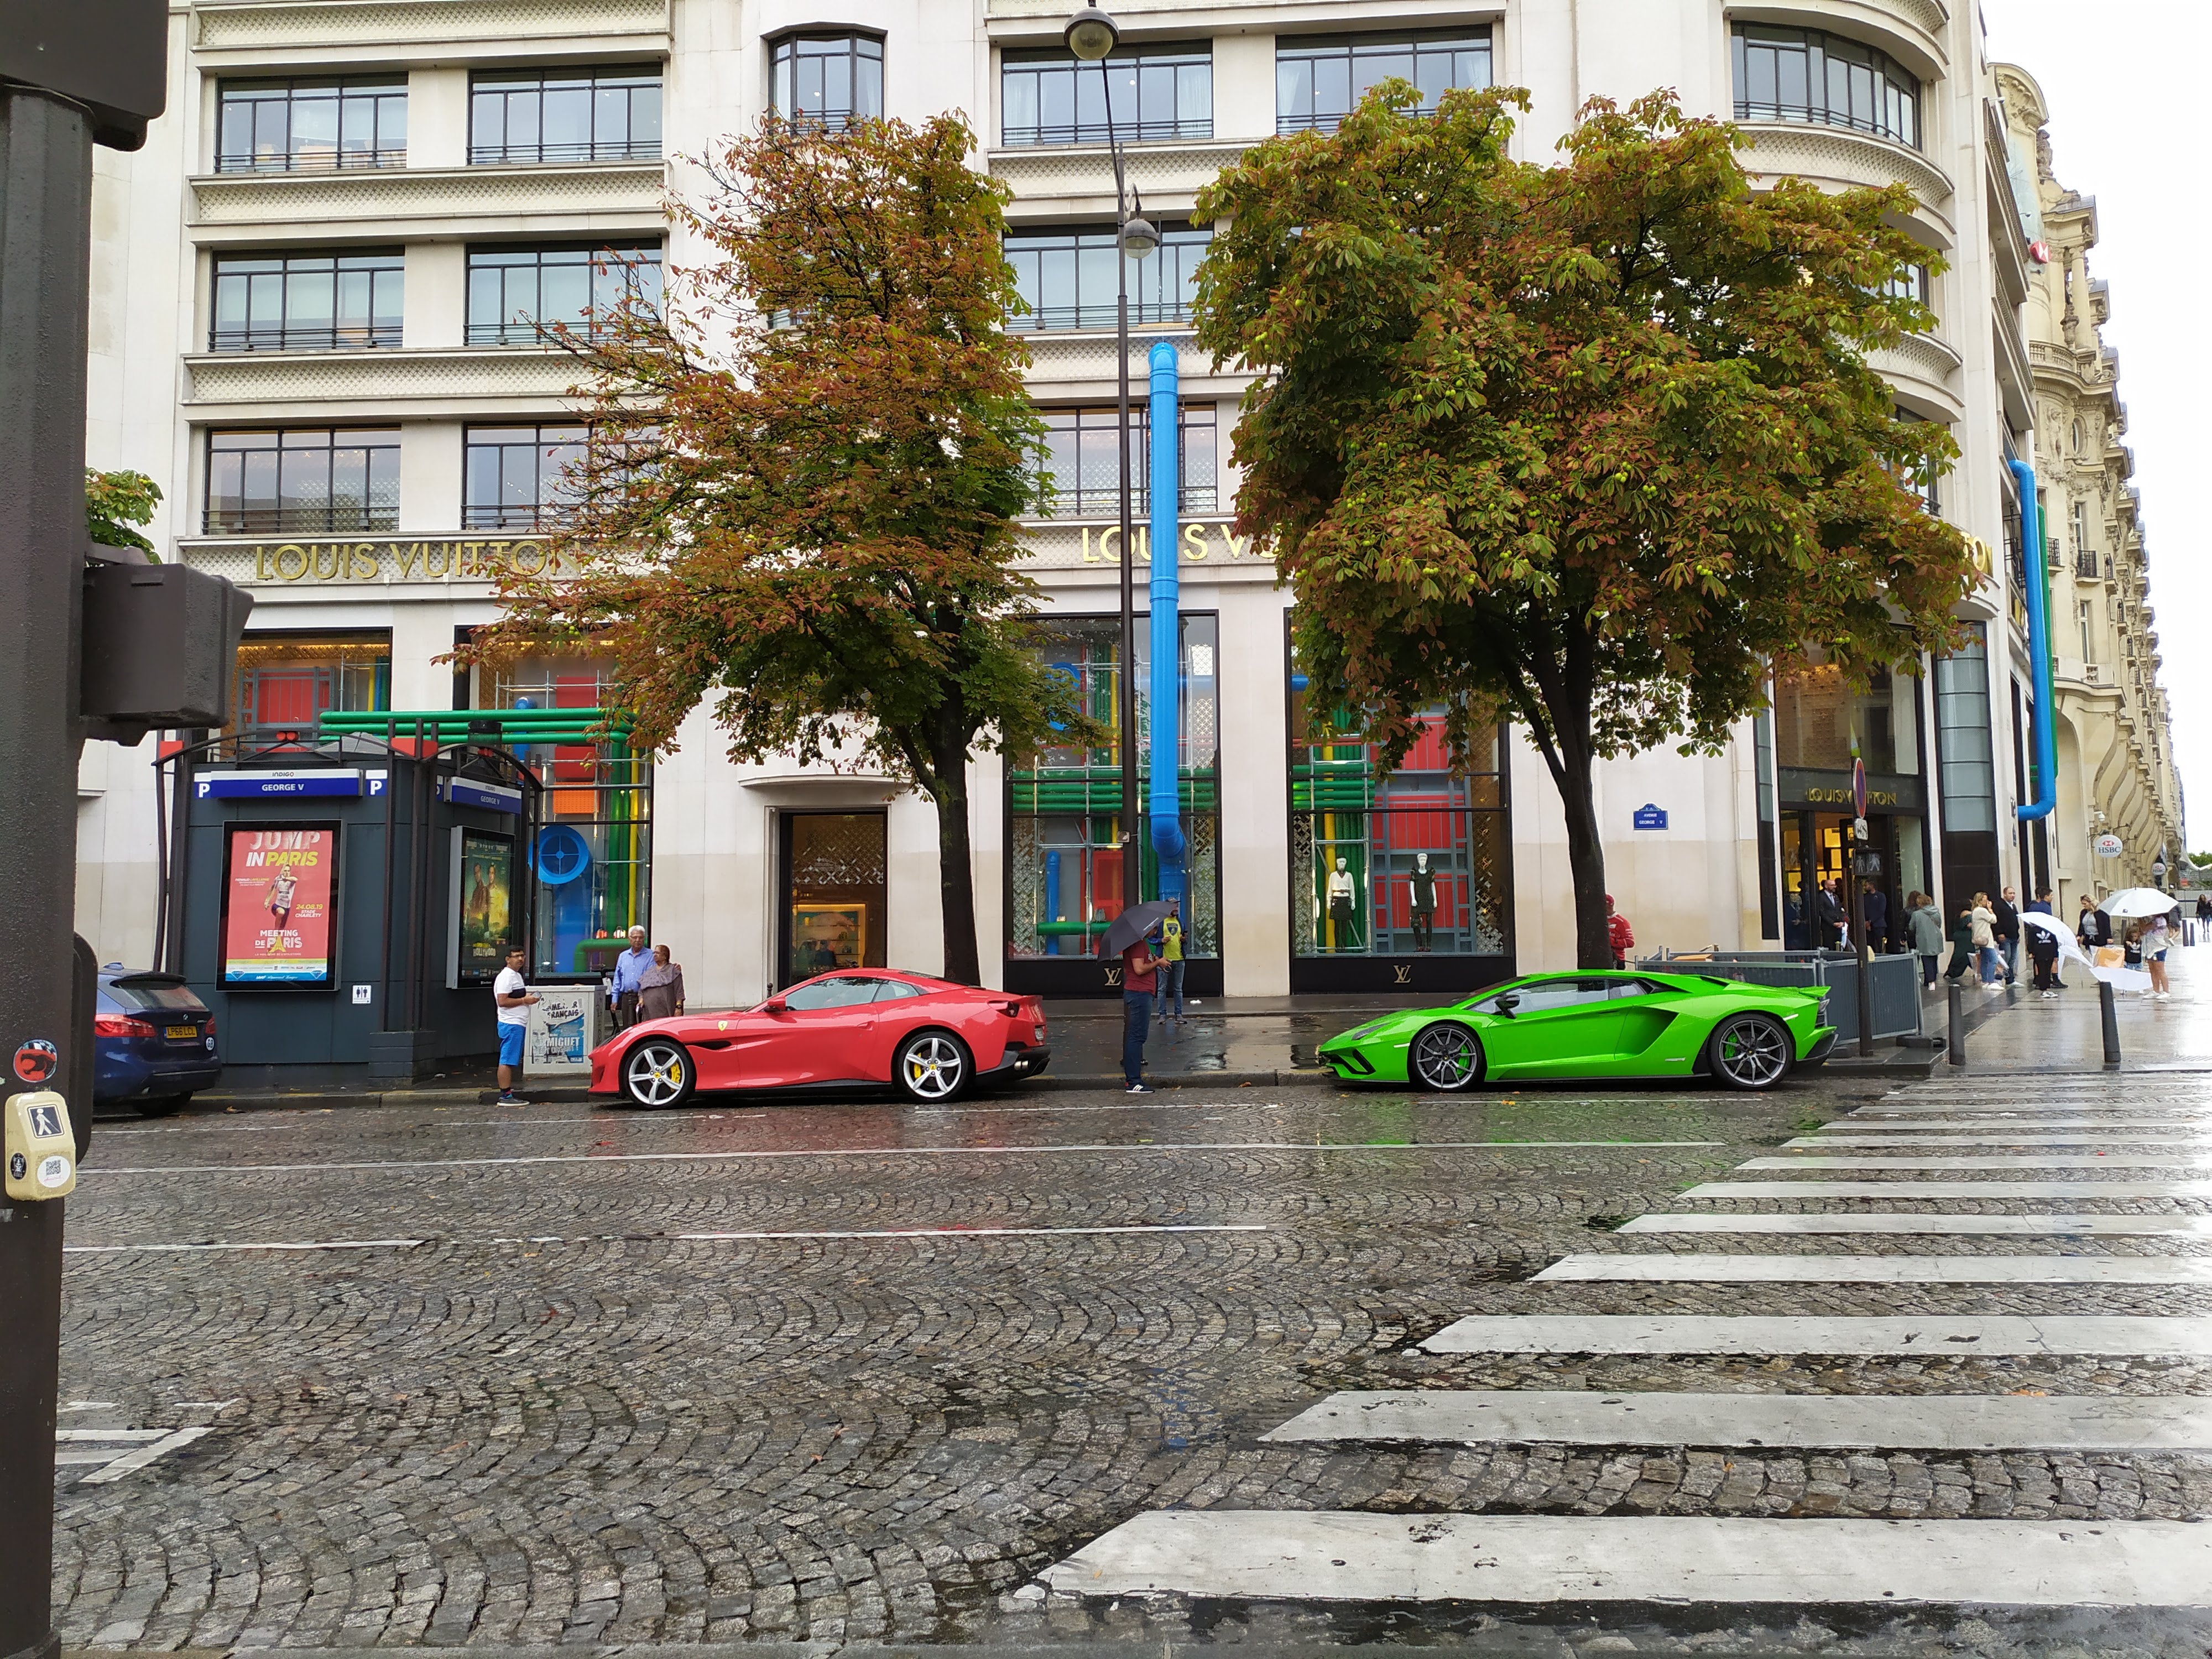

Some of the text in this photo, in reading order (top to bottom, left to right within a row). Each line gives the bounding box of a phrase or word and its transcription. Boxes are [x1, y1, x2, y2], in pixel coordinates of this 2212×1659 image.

[257, 544, 377, 580] LOUIS
[199, 783, 210, 797] P
[370, 780, 382, 795] P
[480, 795, 496, 805] GEORGE
[1808, 787, 1897, 805] LOUIS VTTON
[250, 831, 320, 850] JUMP
[246, 851, 319, 867] IN PARIS
[267, 936, 302, 950] PARIS
[473, 947, 496, 957] HOLLYWOOD
[167, 1027, 196, 1036] LP66 LCL
